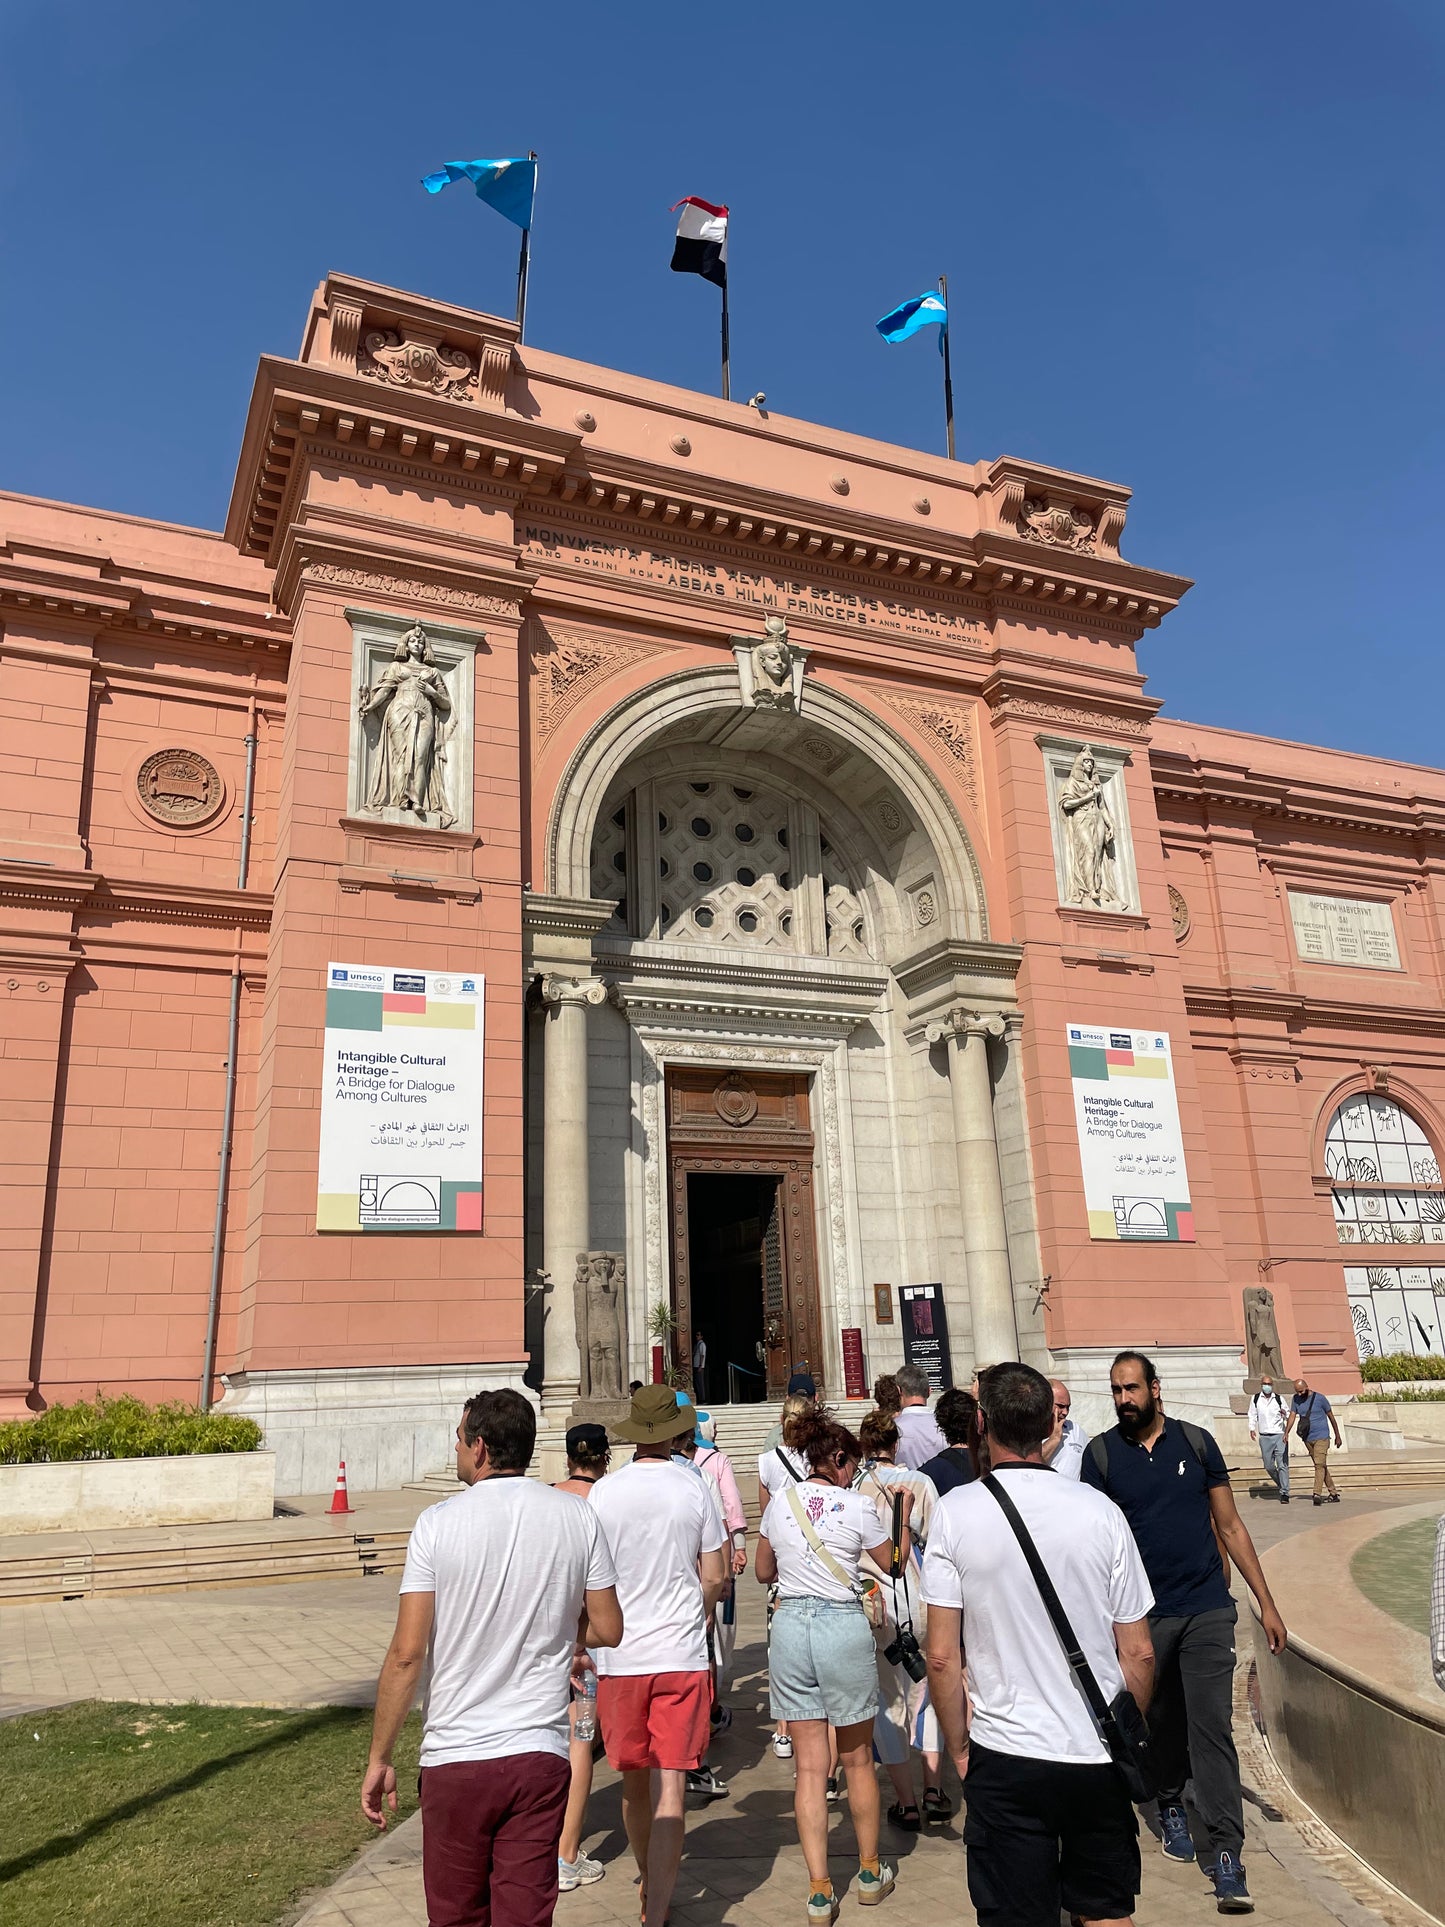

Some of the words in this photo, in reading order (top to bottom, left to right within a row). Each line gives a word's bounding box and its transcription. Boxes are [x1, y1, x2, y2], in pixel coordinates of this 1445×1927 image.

[526, 526, 639, 561] MONVMENTA
[650, 552, 717, 577] PRIORIS
[728, 570, 766, 588] AEVI
[776, 580, 801, 595] HIS
[811, 587, 878, 611] SEDIBVS
[888, 604, 980, 632] COLLOCAVIT
[527, 547, 561, 559] ANNO
[575, 556, 617, 570] DOMINI
[630, 568, 653, 578] MCM
[668, 574, 725, 595] ABBAS
[736, 587, 778, 606] HILMI
[788, 598, 867, 624] PRINCEPS
[879, 620, 901, 629] ANNO
[1310, 901, 1336, 912] IMPERIVM
[1339, 906, 1371, 916] HABVERVNT
[350, 973, 383, 982] unesco
[338, 1050, 397, 1064] Intangible
[400, 1054, 446, 1066] Cultural
[337, 1063, 389, 1078] Heritage
[336, 1076, 345, 1086] A
[349, 1077, 386, 1091] Bridge
[389, 1079, 404, 1089] for
[407, 1080, 456, 1094] Dialogue
[336, 1089, 378, 1104] Among
[381, 1091, 427, 1103] Cultures
[1084, 1096, 1122, 1107] Intangible
[1124, 1099, 1154, 1109] Cultural
[1085, 1106, 1118, 1118] Heritage
[379, 1122, 402, 1134] المادي
[405, 1123, 417, 1133] غير
[420, 1122, 444, 1135] الثقافي
[447, 1123, 470, 1133] التراث
[1086, 1117, 1092, 1125] A
[1094, 1117, 1118, 1129] Bridge
[1120, 1119, 1130, 1128] for
[1131, 1120, 1162, 1131] Dialogue
[1087, 1127, 1115, 1139] Among
[1116, 1129, 1146, 1139] Cultures
[371, 1137, 403, 1145] الثقافات
[407, 1139, 418, 1148] بين
[421, 1138, 445, 1148] للحوار
[448, 1140, 466, 1149] جسر
